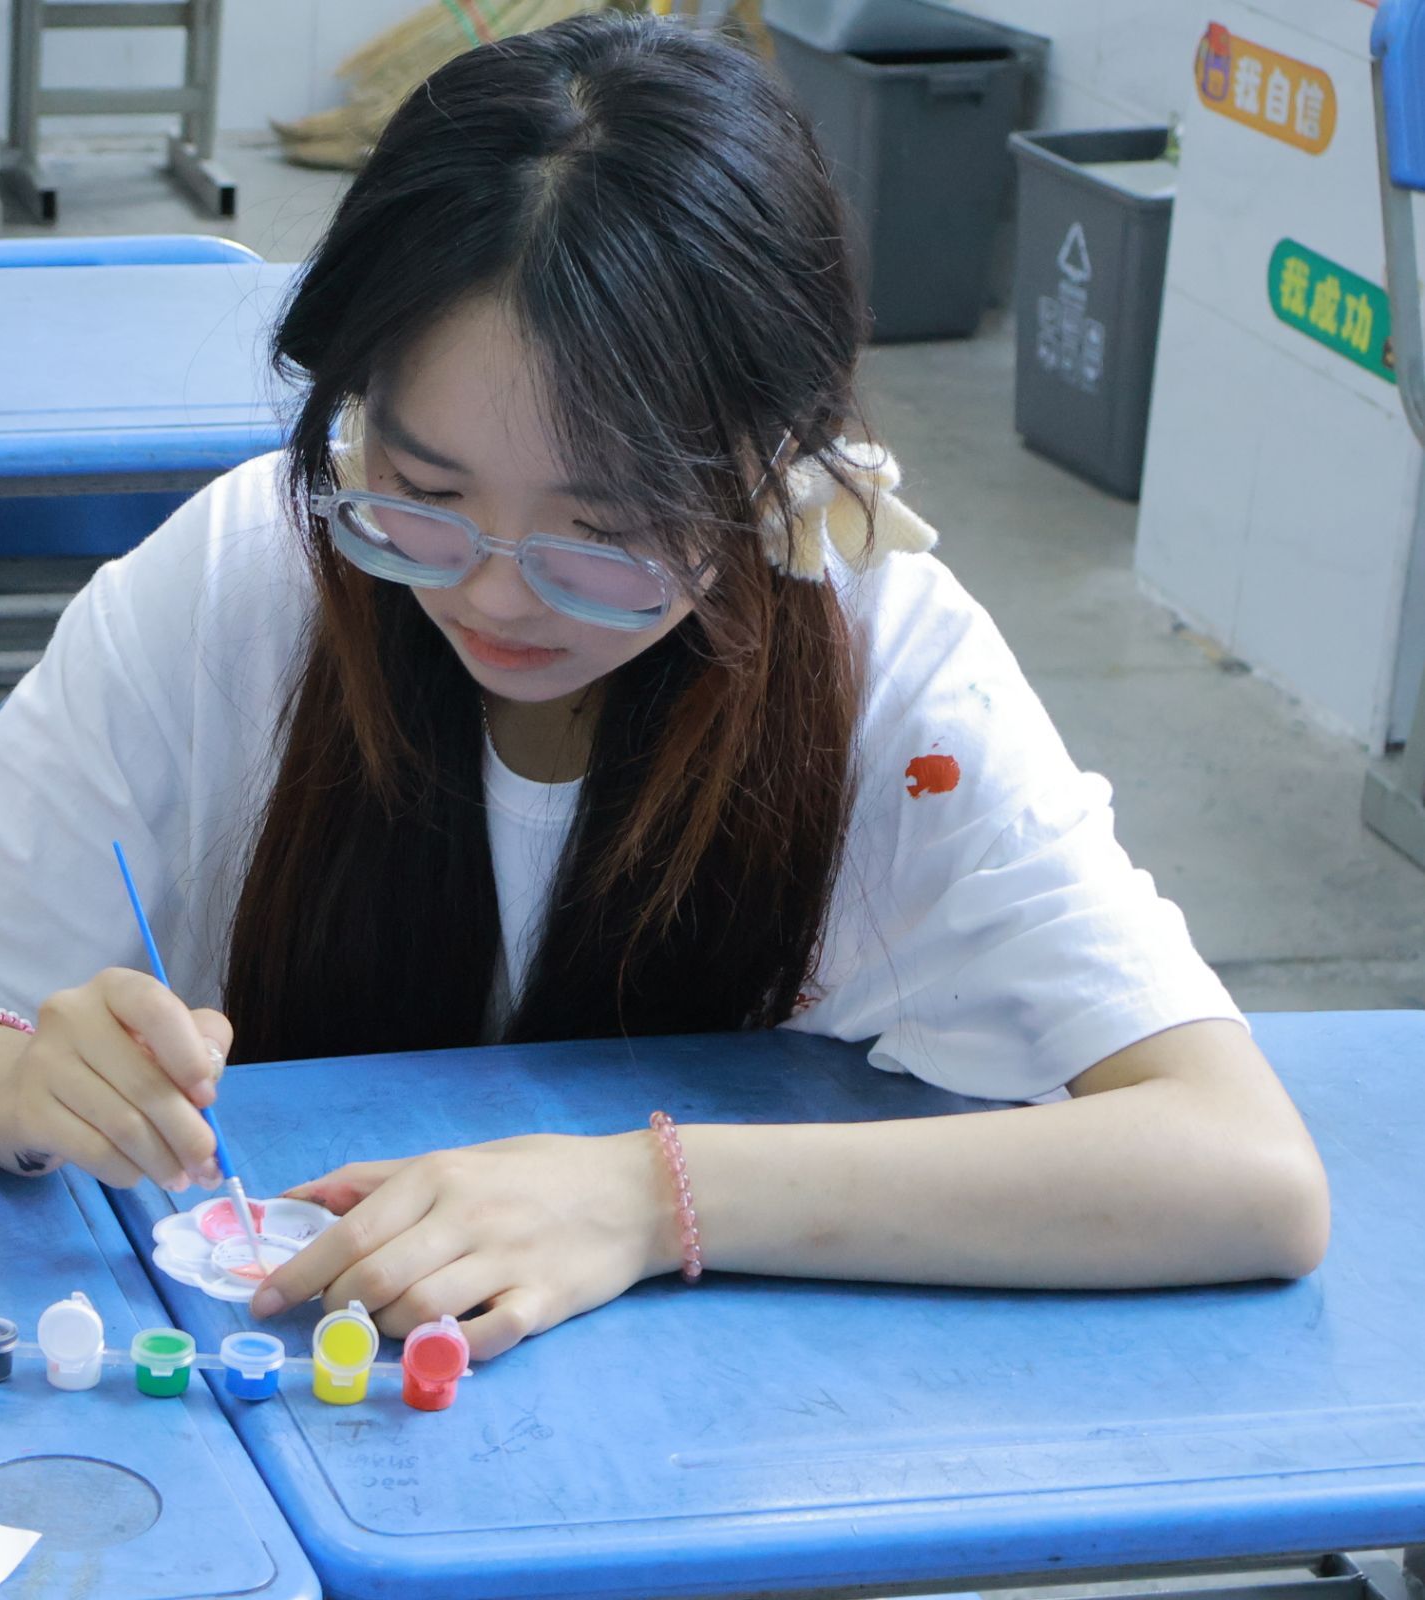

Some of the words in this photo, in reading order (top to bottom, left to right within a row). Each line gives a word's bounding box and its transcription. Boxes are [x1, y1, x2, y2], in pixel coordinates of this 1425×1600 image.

[1233, 54, 1324, 140] 我自信
[1278, 256, 1373, 354] 我成功
